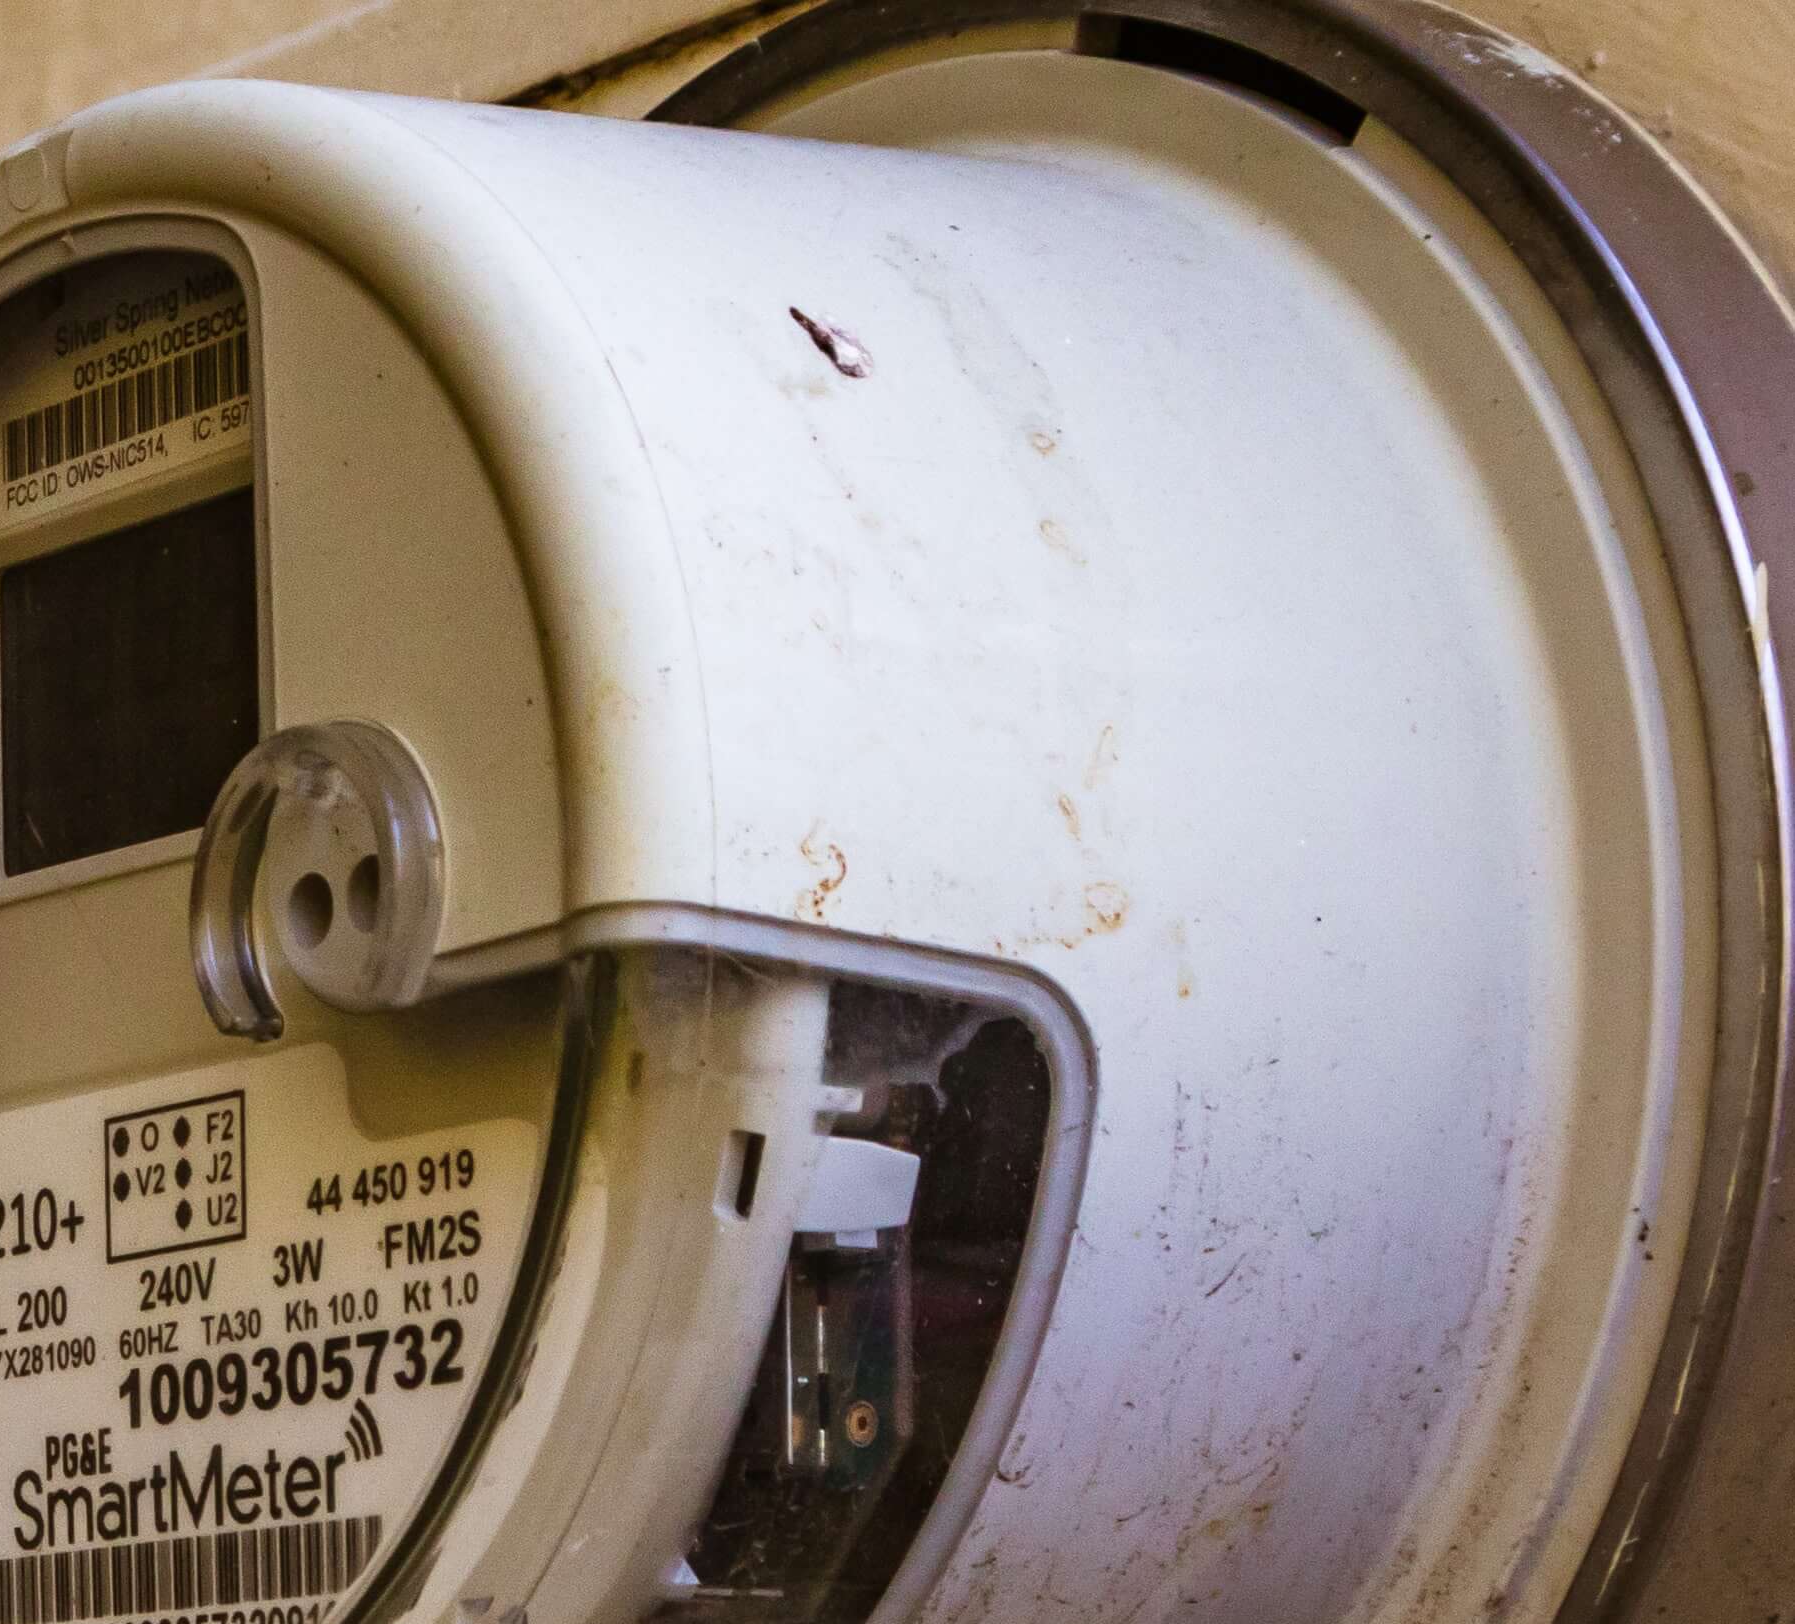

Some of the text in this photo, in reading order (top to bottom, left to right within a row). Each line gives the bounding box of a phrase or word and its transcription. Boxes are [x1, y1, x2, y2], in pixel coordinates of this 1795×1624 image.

[55, 316, 108, 357] Silver
[115, 288, 179, 336] Spring
[7, 478, 38, 511] FCC
[205, 1109, 235, 1144] F2
[135, 1151, 234, 1196] V2 J2
[307, 1148, 475, 1215] 44 450 919
[206, 1192, 238, 1226] U2
[17, 1286, 68, 1333] 200
[139, 1257, 217, 1311] 240V
[272, 1237, 325, 1288] 3W
[383, 1210, 482, 1269] FM2S
[118, 1321, 179, 1360] 60HZ
[200, 1308, 262, 1346] TA30
[285, 1301, 319, 1333] Kh
[327, 1288, 379, 1325] 10.0
[403, 1281, 432, 1313] Kt
[440, 1272, 480, 1309] 1.0
[118, 1318, 465, 1429] 1009305732
[45, 1427, 113, 1481] PG&E
[13, 1444, 347, 1551] SmartMeter
